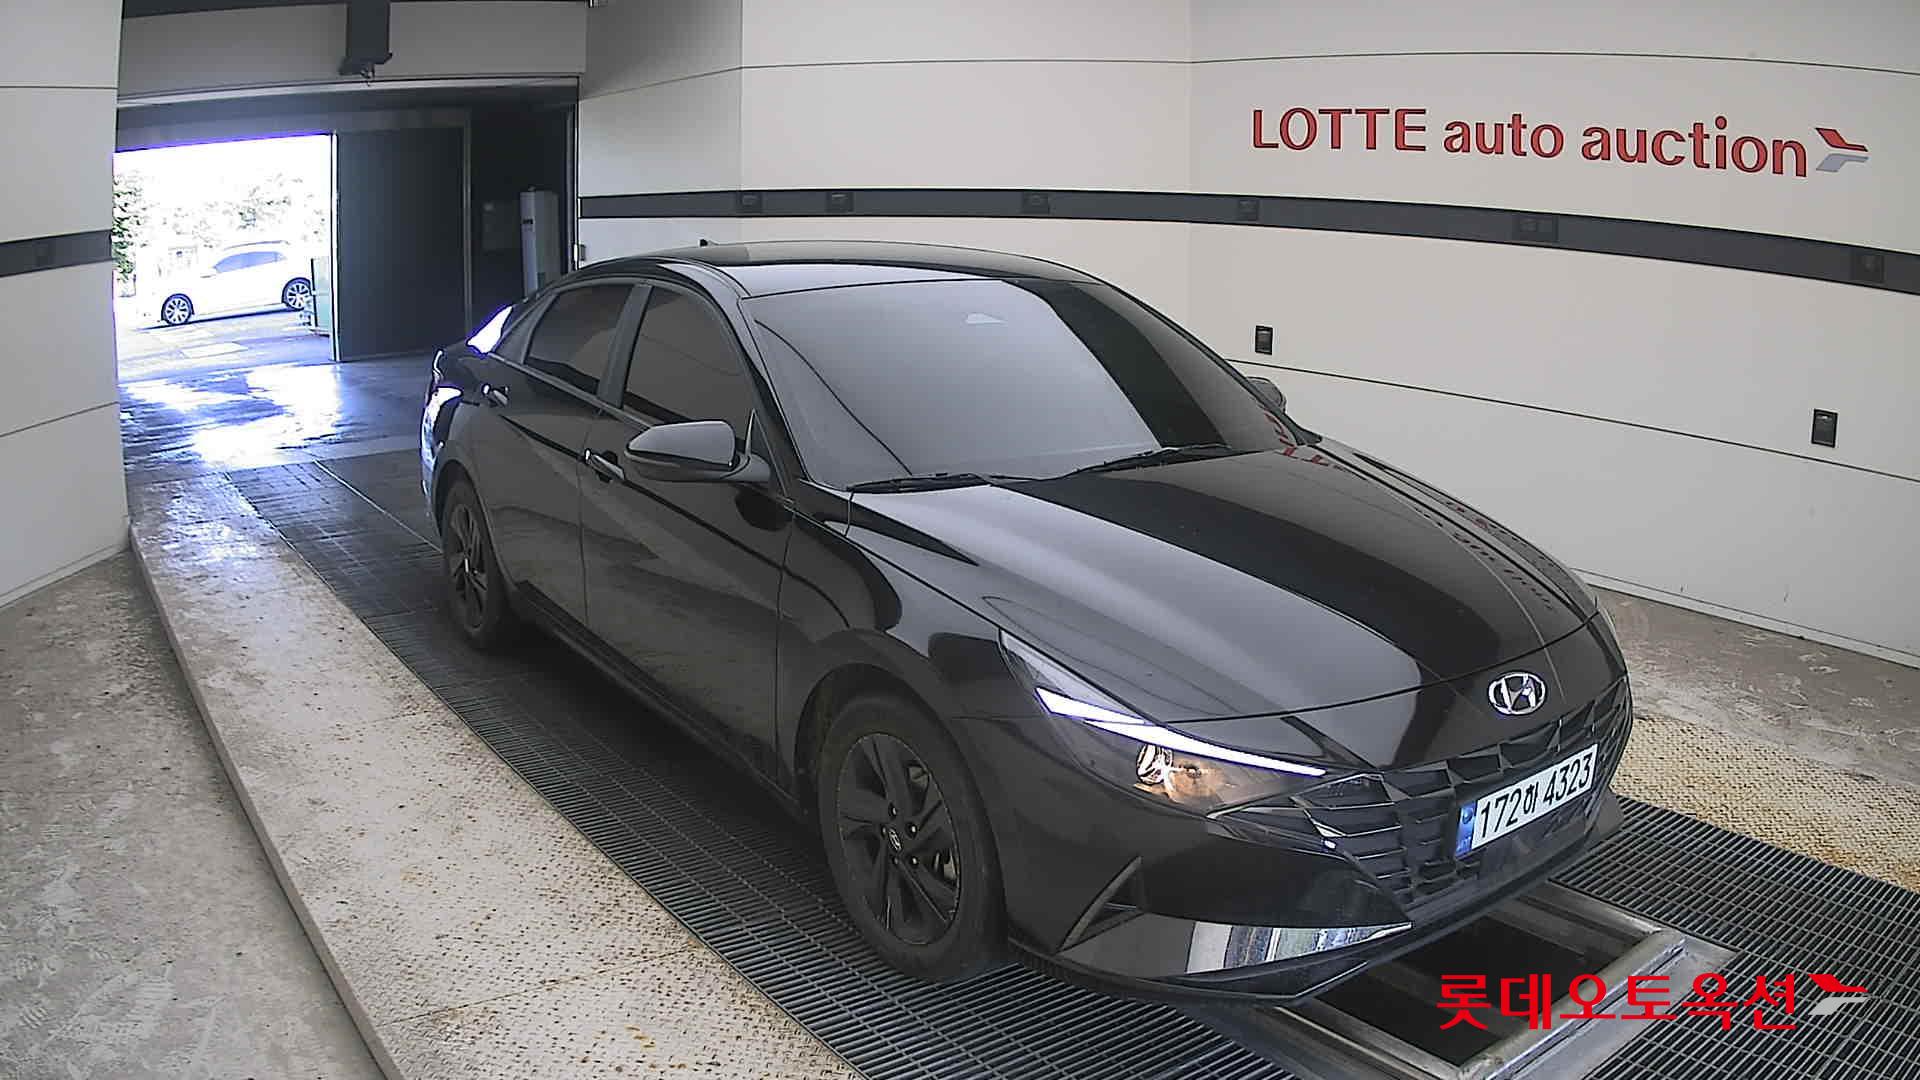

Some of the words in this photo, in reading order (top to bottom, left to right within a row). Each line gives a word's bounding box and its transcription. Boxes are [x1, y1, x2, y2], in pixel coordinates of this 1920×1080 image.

[1252, 108, 1427, 152] LOTTE
[1443, 113, 1565, 158] auto
[1580, 116, 1808, 178] auction
[1481, 781, 1539, 838] 172하
[1543, 752, 1593, 806] 4323
